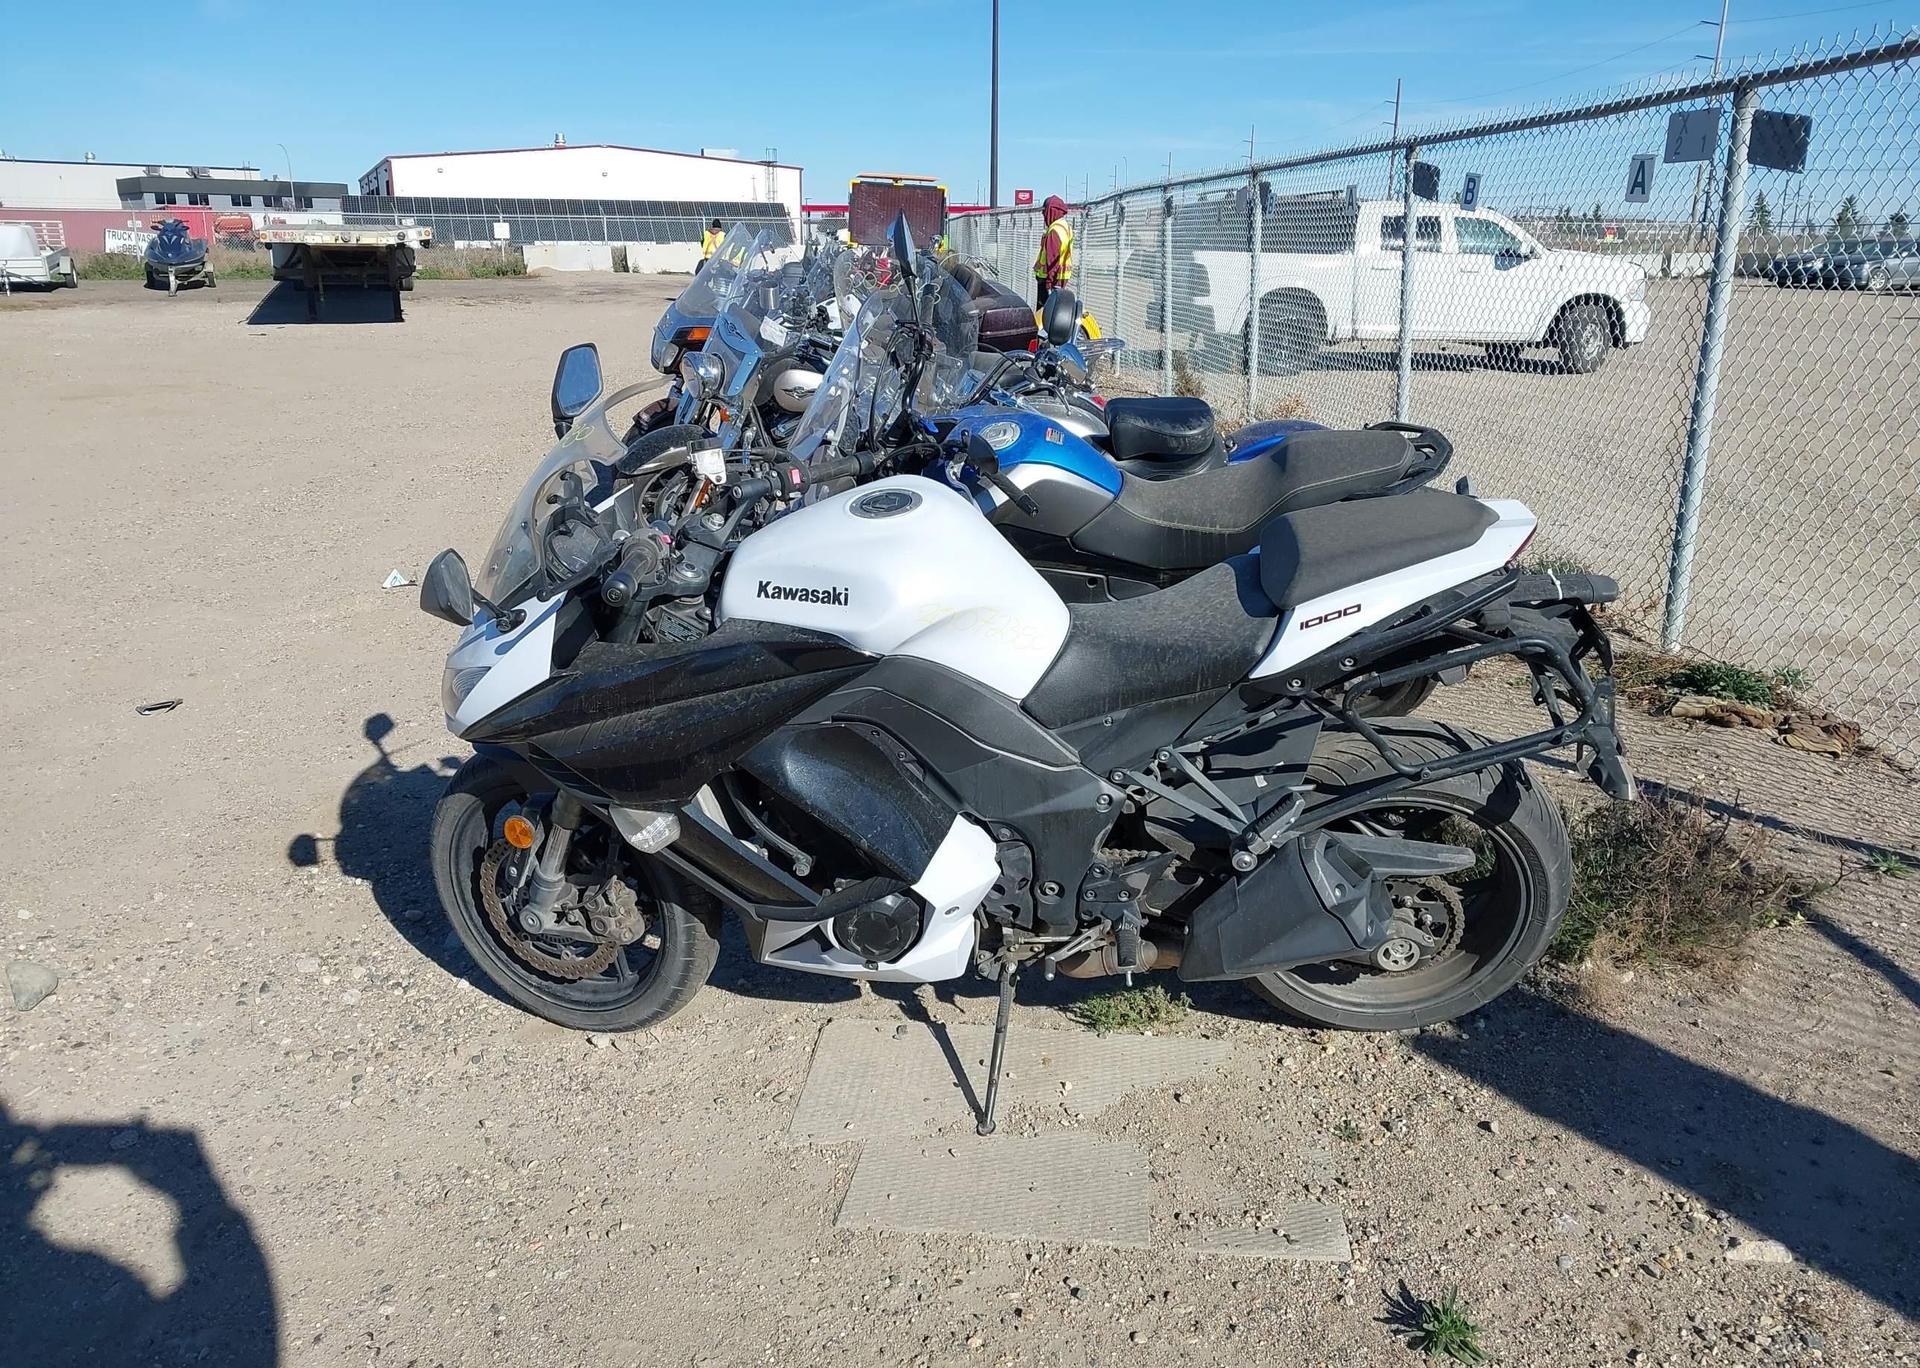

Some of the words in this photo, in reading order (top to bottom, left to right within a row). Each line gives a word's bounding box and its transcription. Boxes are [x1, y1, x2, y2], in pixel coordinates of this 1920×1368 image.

[1674, 136, 1683, 155] 2
[1700, 135, 1707, 153] 1
[1630, 161, 1646, 194] A
[1465, 178, 1476, 204] B
[108, 230, 132, 242] TRUCK
[122, 243, 143, 254] OPEN
[756, 580, 849, 607] Kawasaki
[1299, 603, 1361, 631] 1000
